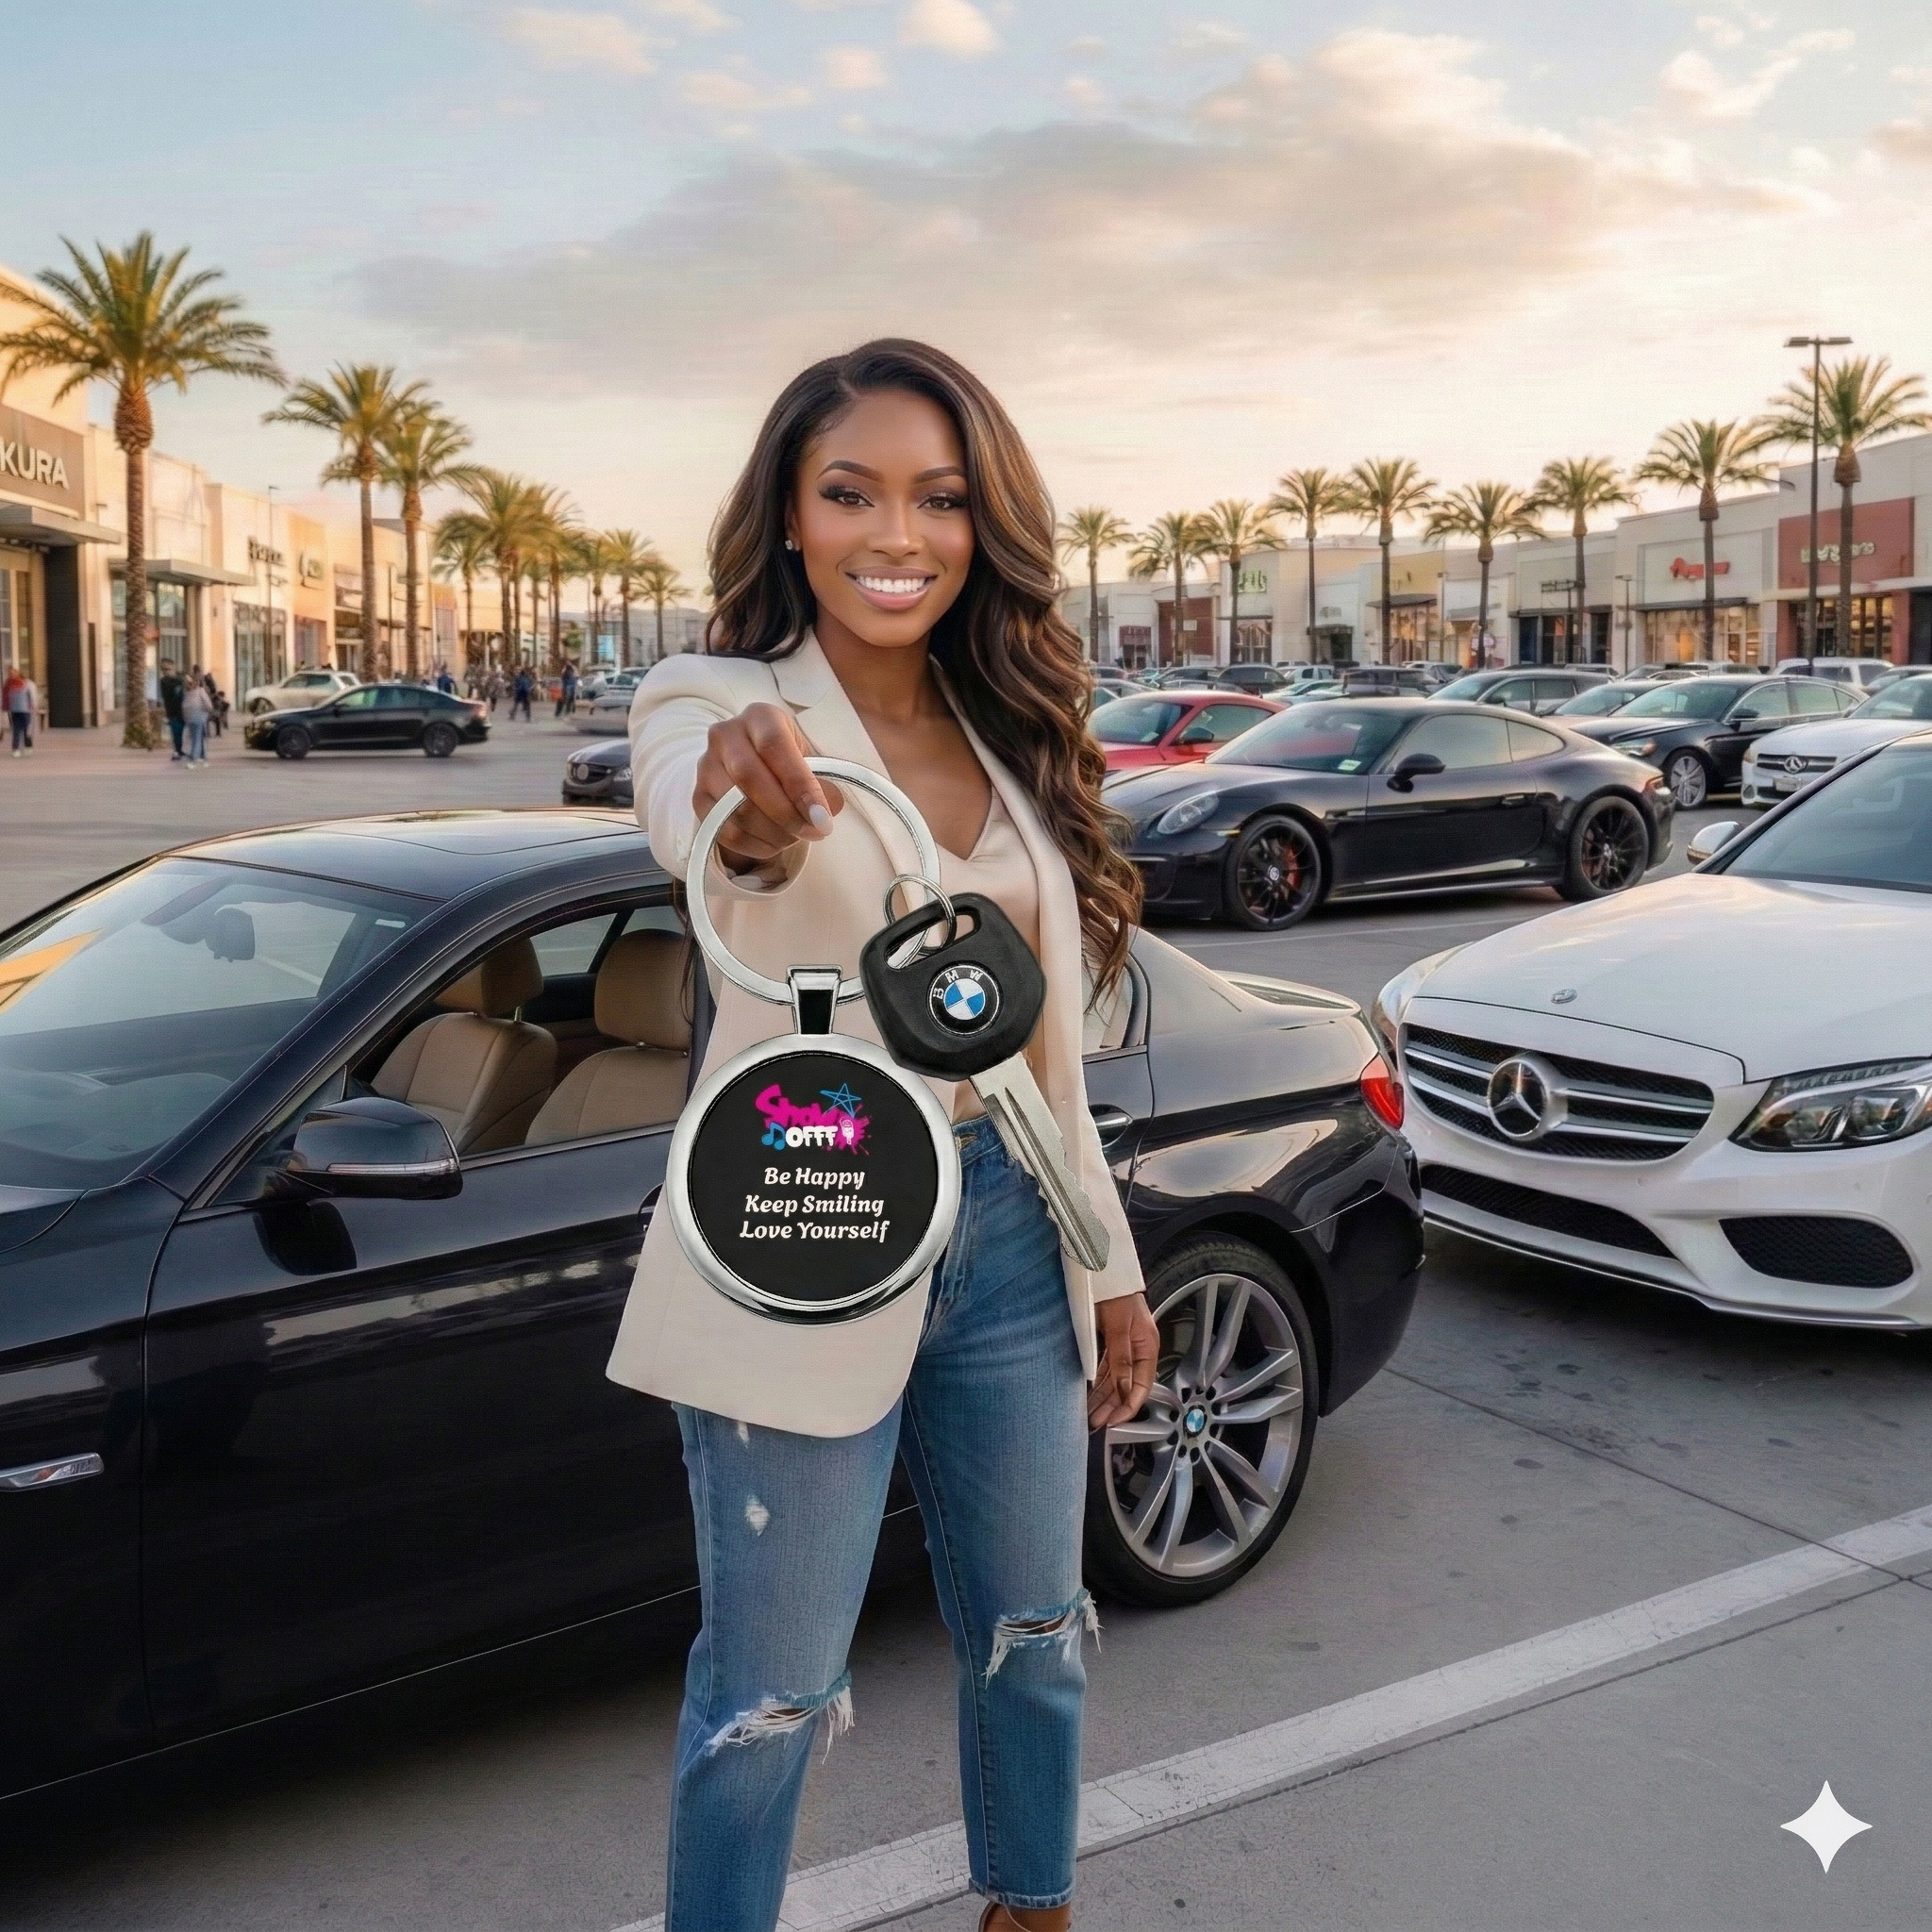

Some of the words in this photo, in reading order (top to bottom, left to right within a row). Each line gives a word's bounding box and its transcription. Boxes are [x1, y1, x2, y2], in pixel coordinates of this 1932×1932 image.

[932, 969, 983, 1000] BMW
[764, 1167, 791, 1185] Be
[795, 1167, 865, 1190] Happy
[744, 1194, 798, 1217] Keep
[802, 1194, 884, 1217] Smiling
[740, 1220, 792, 1240] Love
[796, 1220, 890, 1243] Yourself
